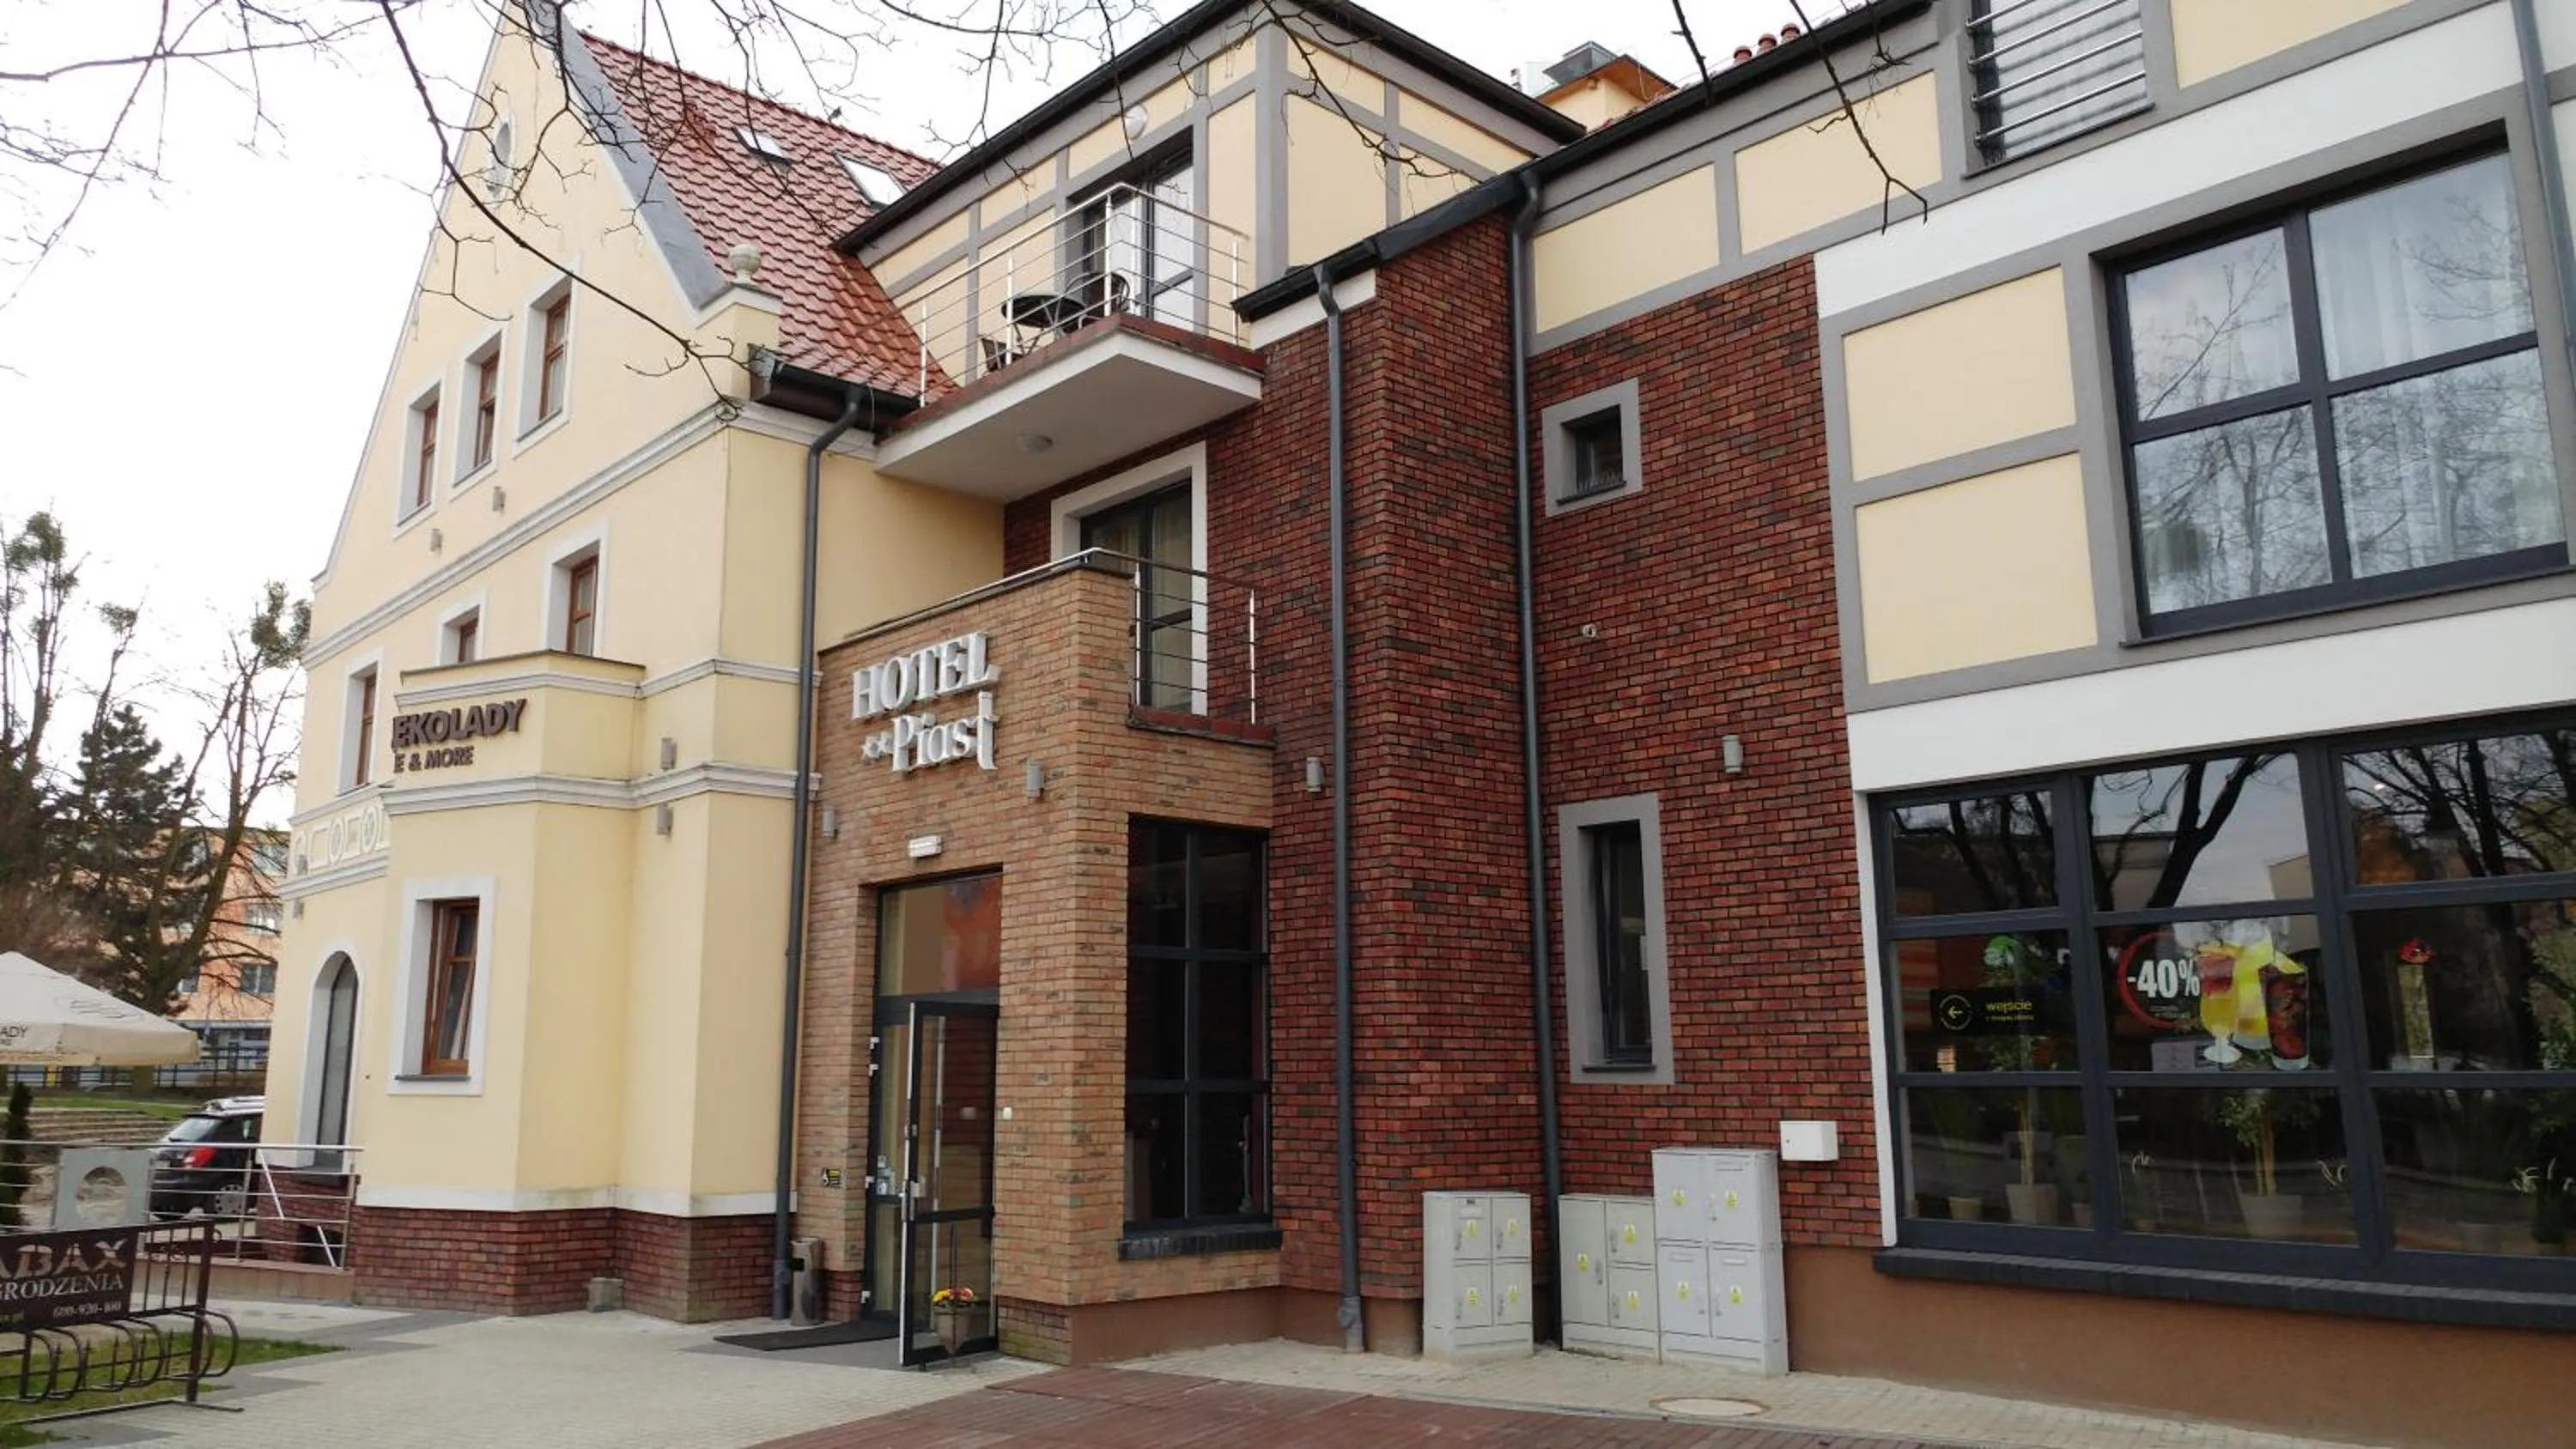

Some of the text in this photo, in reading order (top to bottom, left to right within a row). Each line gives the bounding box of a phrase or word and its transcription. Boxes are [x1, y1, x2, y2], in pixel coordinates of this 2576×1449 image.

[851, 631, 1001, 720] HOTEL
[392, 699, 527, 749] EKOLADY
[891, 691, 999, 772] Piast
[424, 745, 474, 770] MORE
[2127, 958, 2200, 998] -40%
[0, 1273, 124, 1300] RODZENIA
